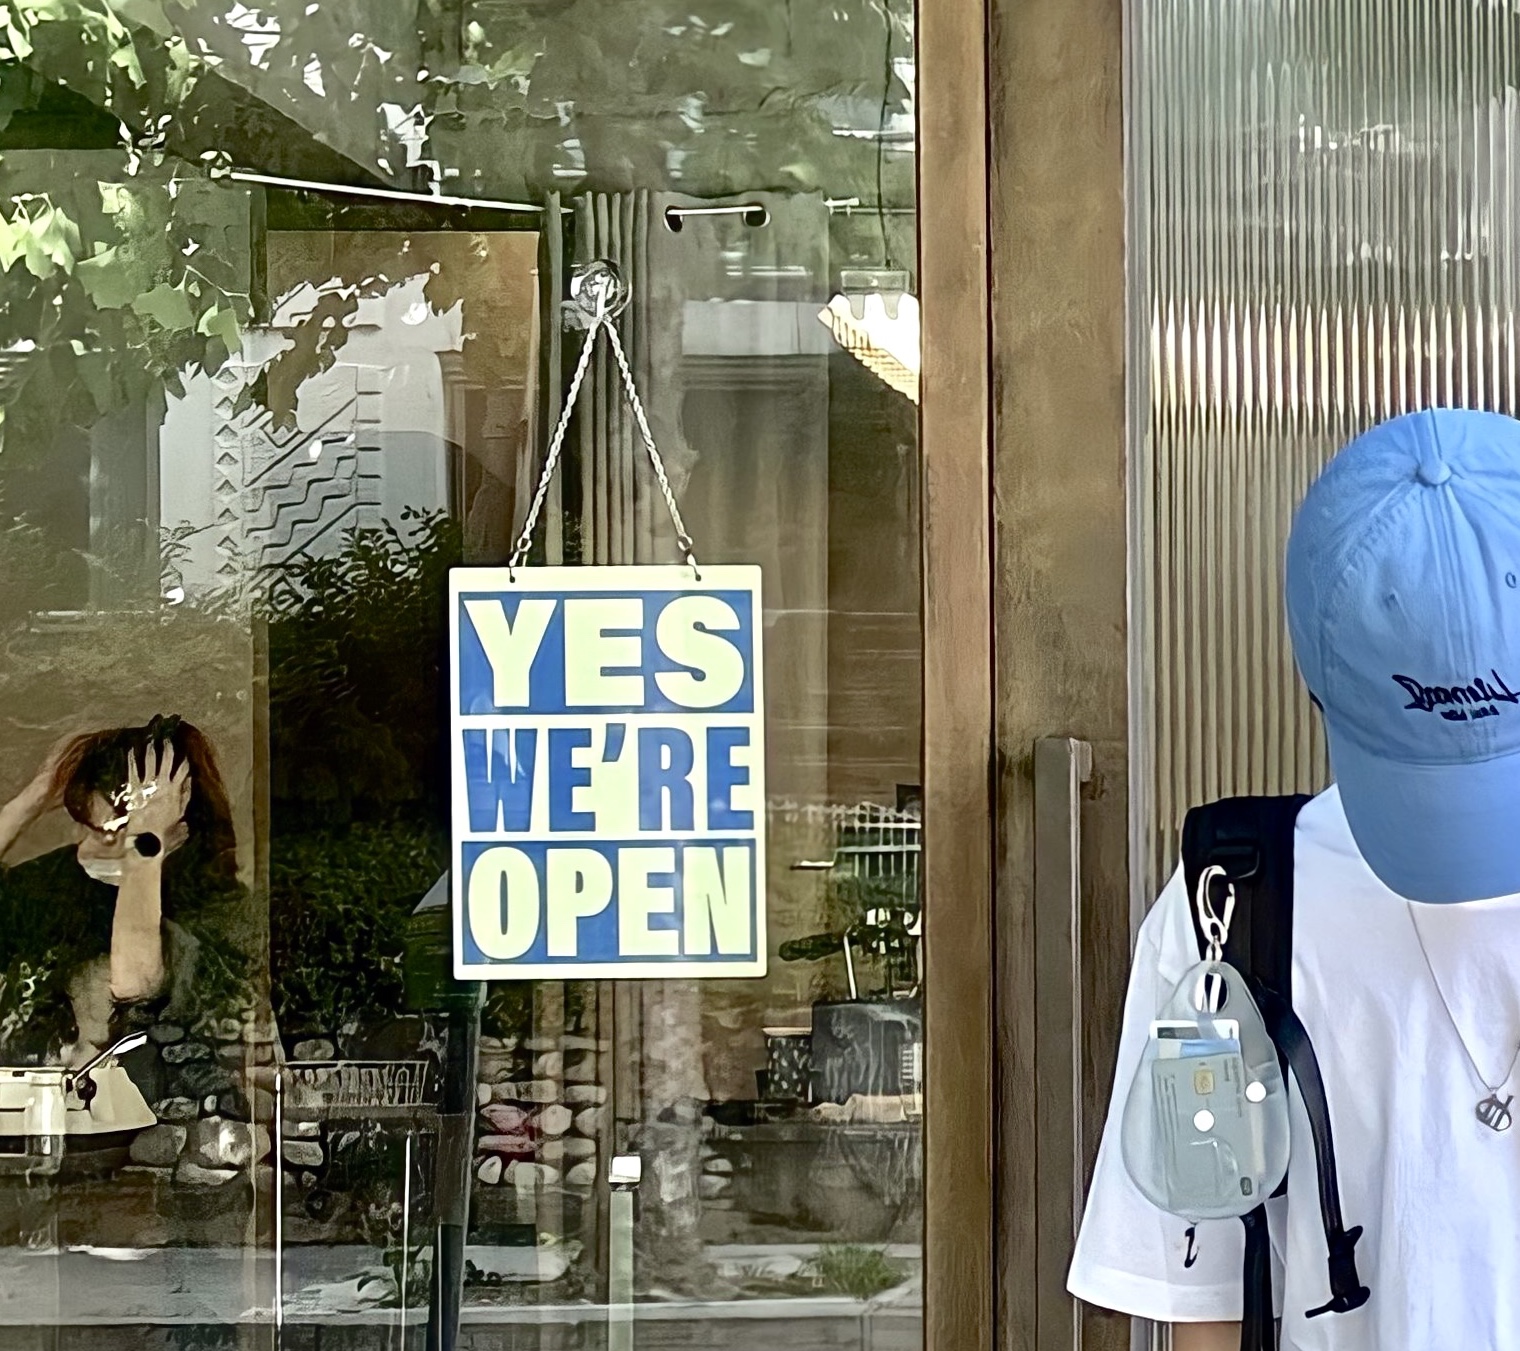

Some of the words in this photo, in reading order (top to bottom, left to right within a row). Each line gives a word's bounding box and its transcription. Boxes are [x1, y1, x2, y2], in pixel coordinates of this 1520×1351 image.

[463, 595, 745, 708] YES
[462, 723, 754, 832] WE'RE
[468, 846, 751, 960] OPEN
